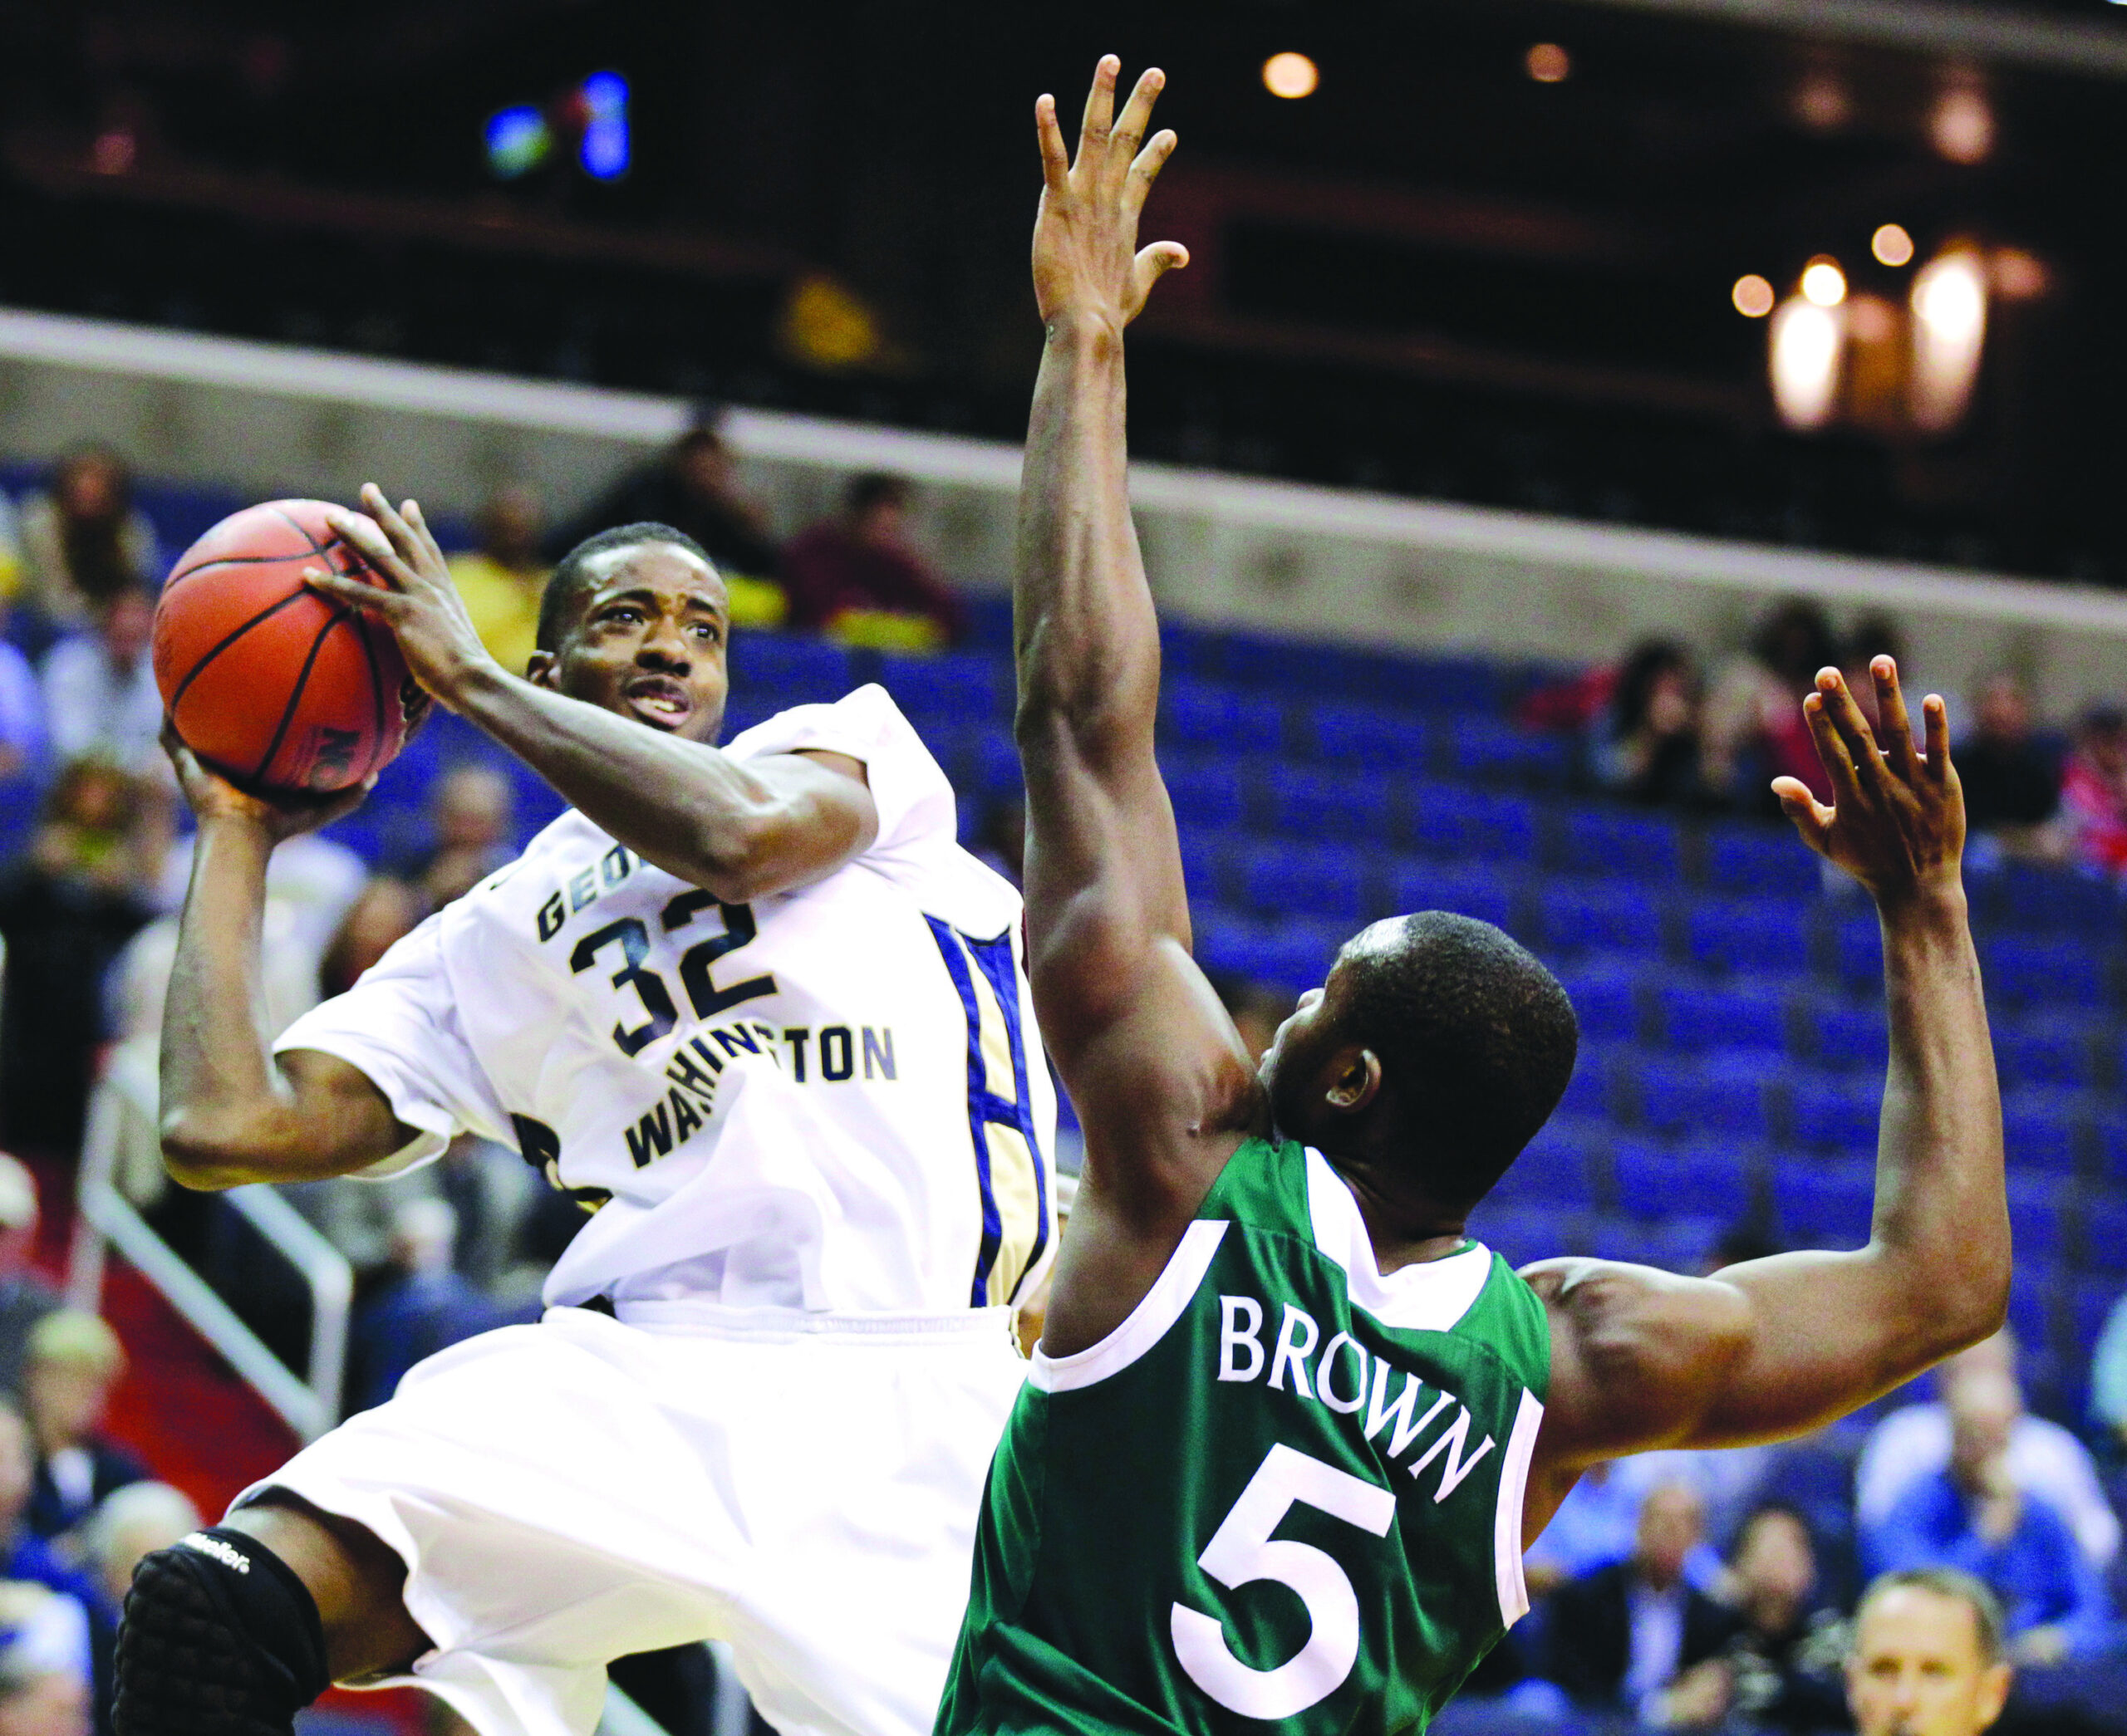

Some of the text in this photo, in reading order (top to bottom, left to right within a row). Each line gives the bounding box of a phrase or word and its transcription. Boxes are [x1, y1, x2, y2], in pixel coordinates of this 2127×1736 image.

[535, 842, 651, 944] GEO
[569, 887, 780, 1059] 32
[623, 1021, 897, 1170] WAHINTON
[1216, 1294, 1496, 1504] BROWN
[1170, 1442, 1397, 1720] 5
